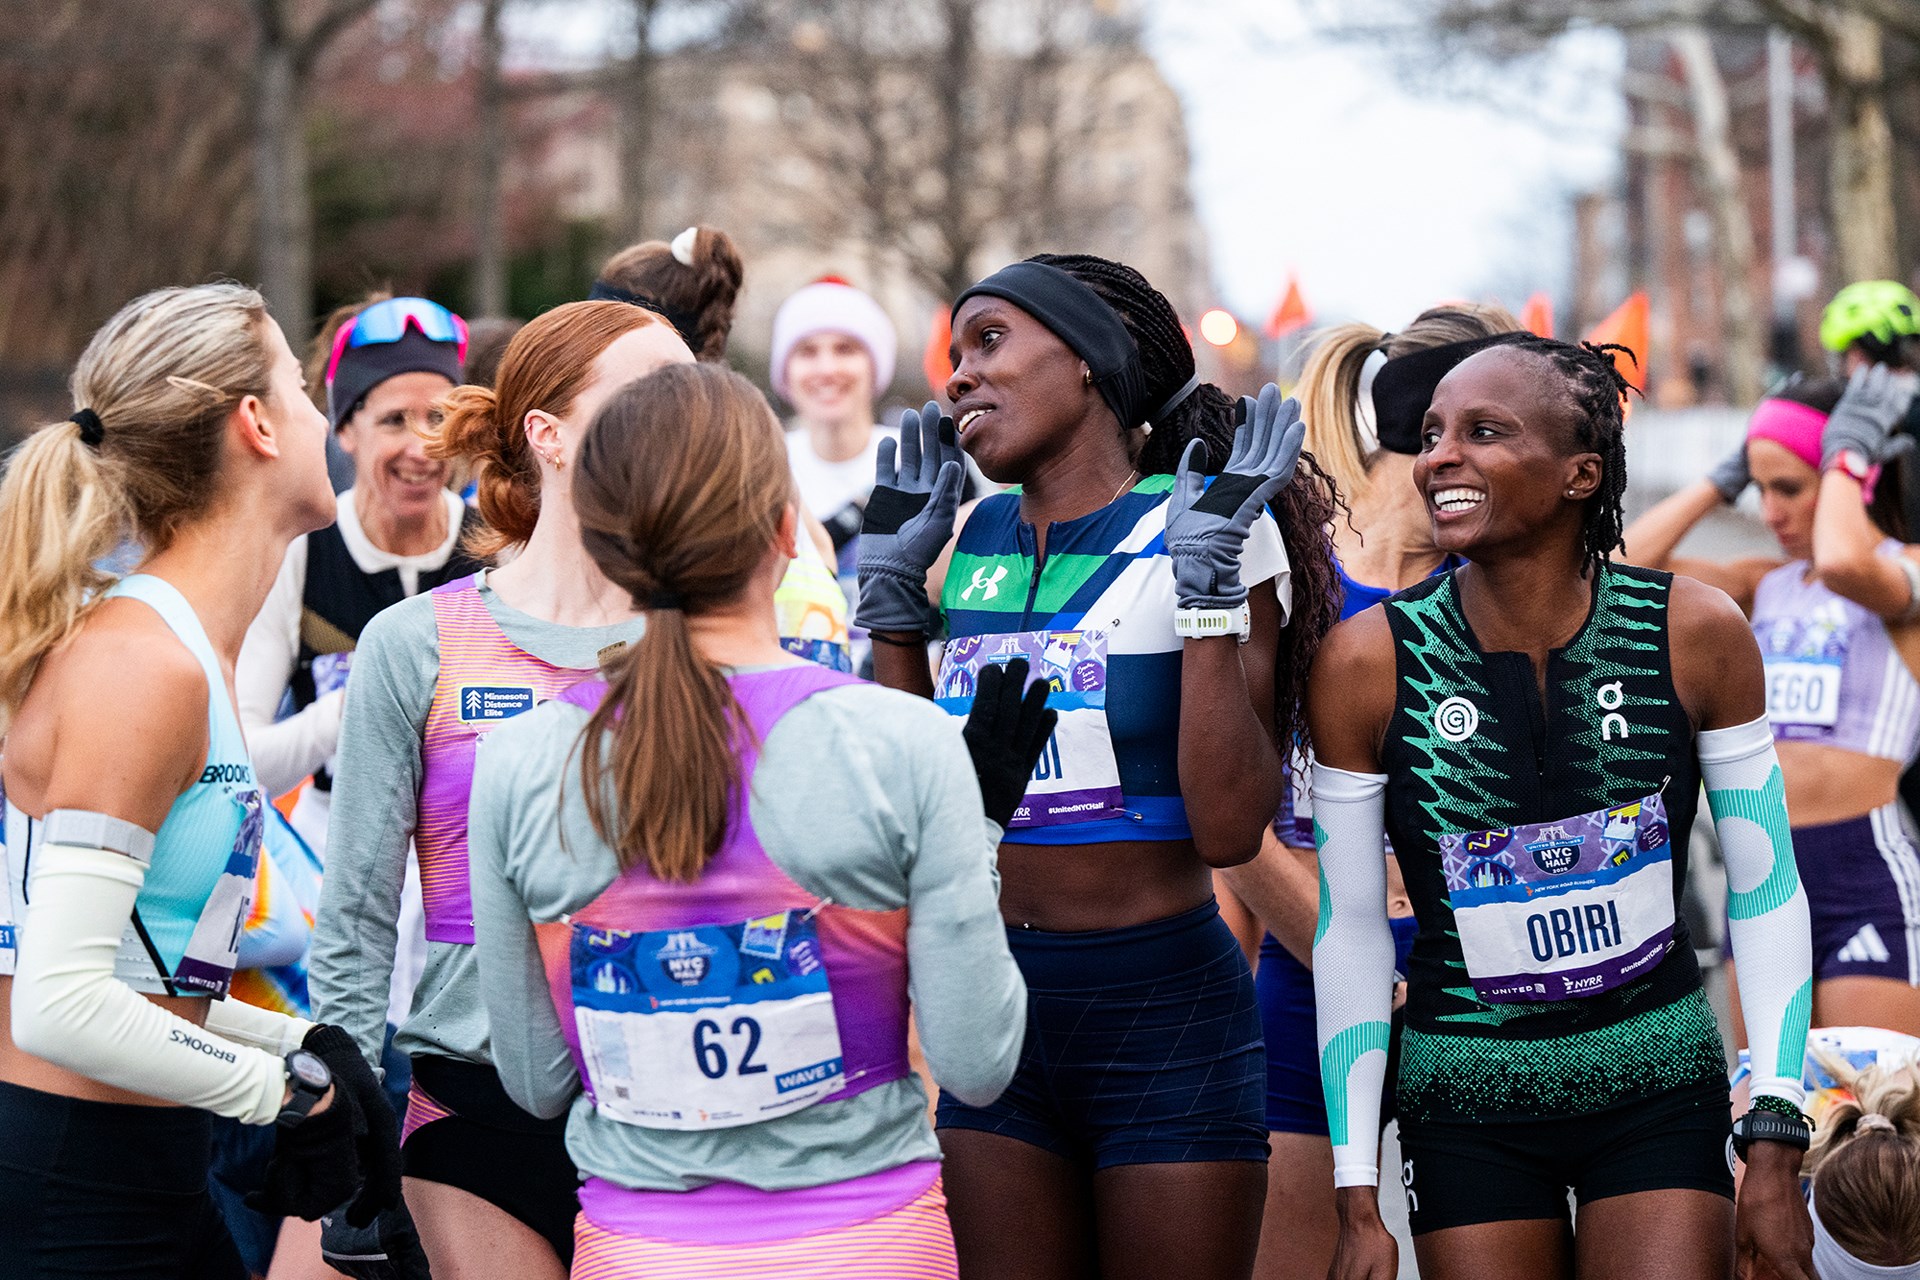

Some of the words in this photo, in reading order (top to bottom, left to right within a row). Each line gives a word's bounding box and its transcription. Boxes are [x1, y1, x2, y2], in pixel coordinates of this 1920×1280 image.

[483, 692, 530, 700] Minnesota
[483, 700, 523, 708] Distance
[483, 709, 504, 717] Elite
[1048, 801, 1105, 814] #UnitedNYCHalf
[1540, 847, 1573, 861] NYC
[1545, 857, 1572, 869] HALF
[1526, 899, 1623, 963] OBIRI
[1574, 974, 1603, 989] NYRR
[1492, 984, 1533, 995] UNITED
[169, 1029, 237, 1064] BROOKS
[692, 1016, 768, 1080] 62
[779, 1065, 826, 1089] WAVE
[828, 1061, 837, 1074] 1
